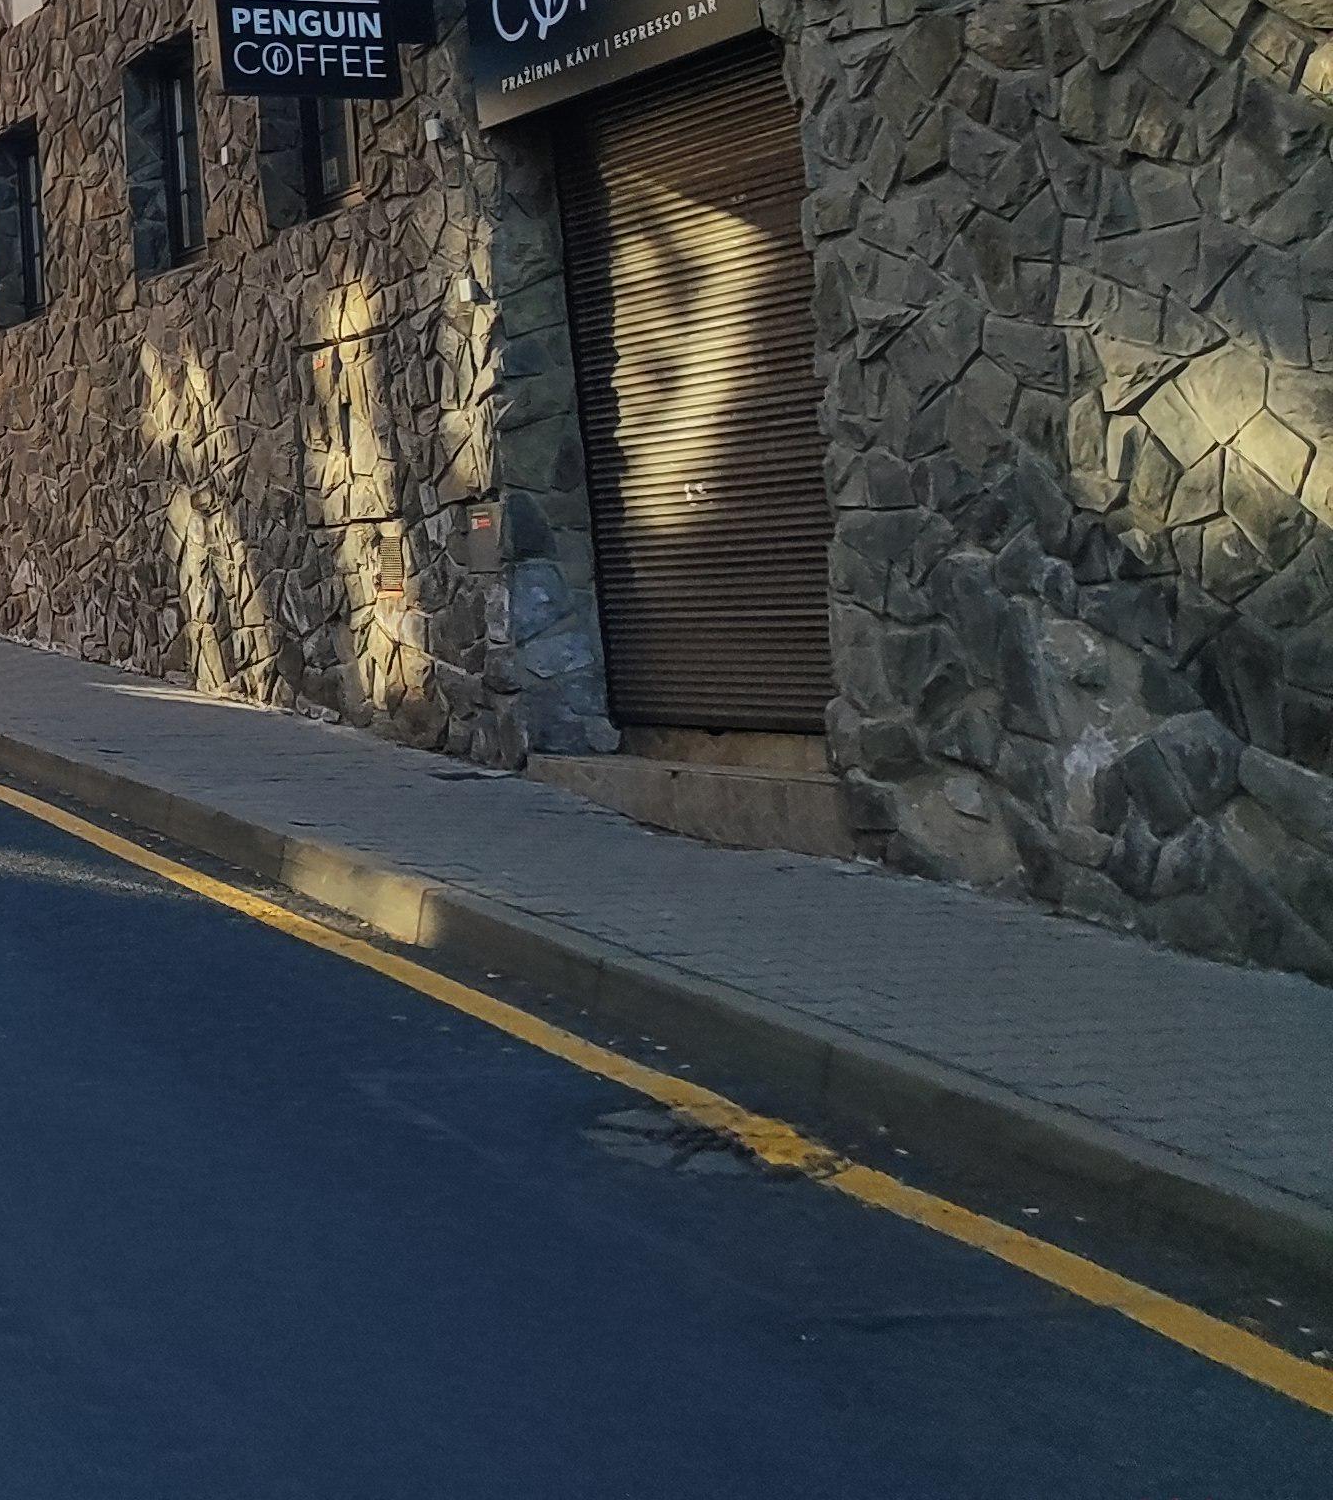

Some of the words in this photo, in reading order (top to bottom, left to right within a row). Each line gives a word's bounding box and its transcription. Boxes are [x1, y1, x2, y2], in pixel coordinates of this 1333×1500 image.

[231, 7, 382, 39] PENGUIN
[233, 41, 387, 78] COFFEE
[501, 58, 562, 94] PRAŽÍRNA
[565, 41, 600, 68] KÁVY
[613, 10, 682, 50] ESPRESSO
